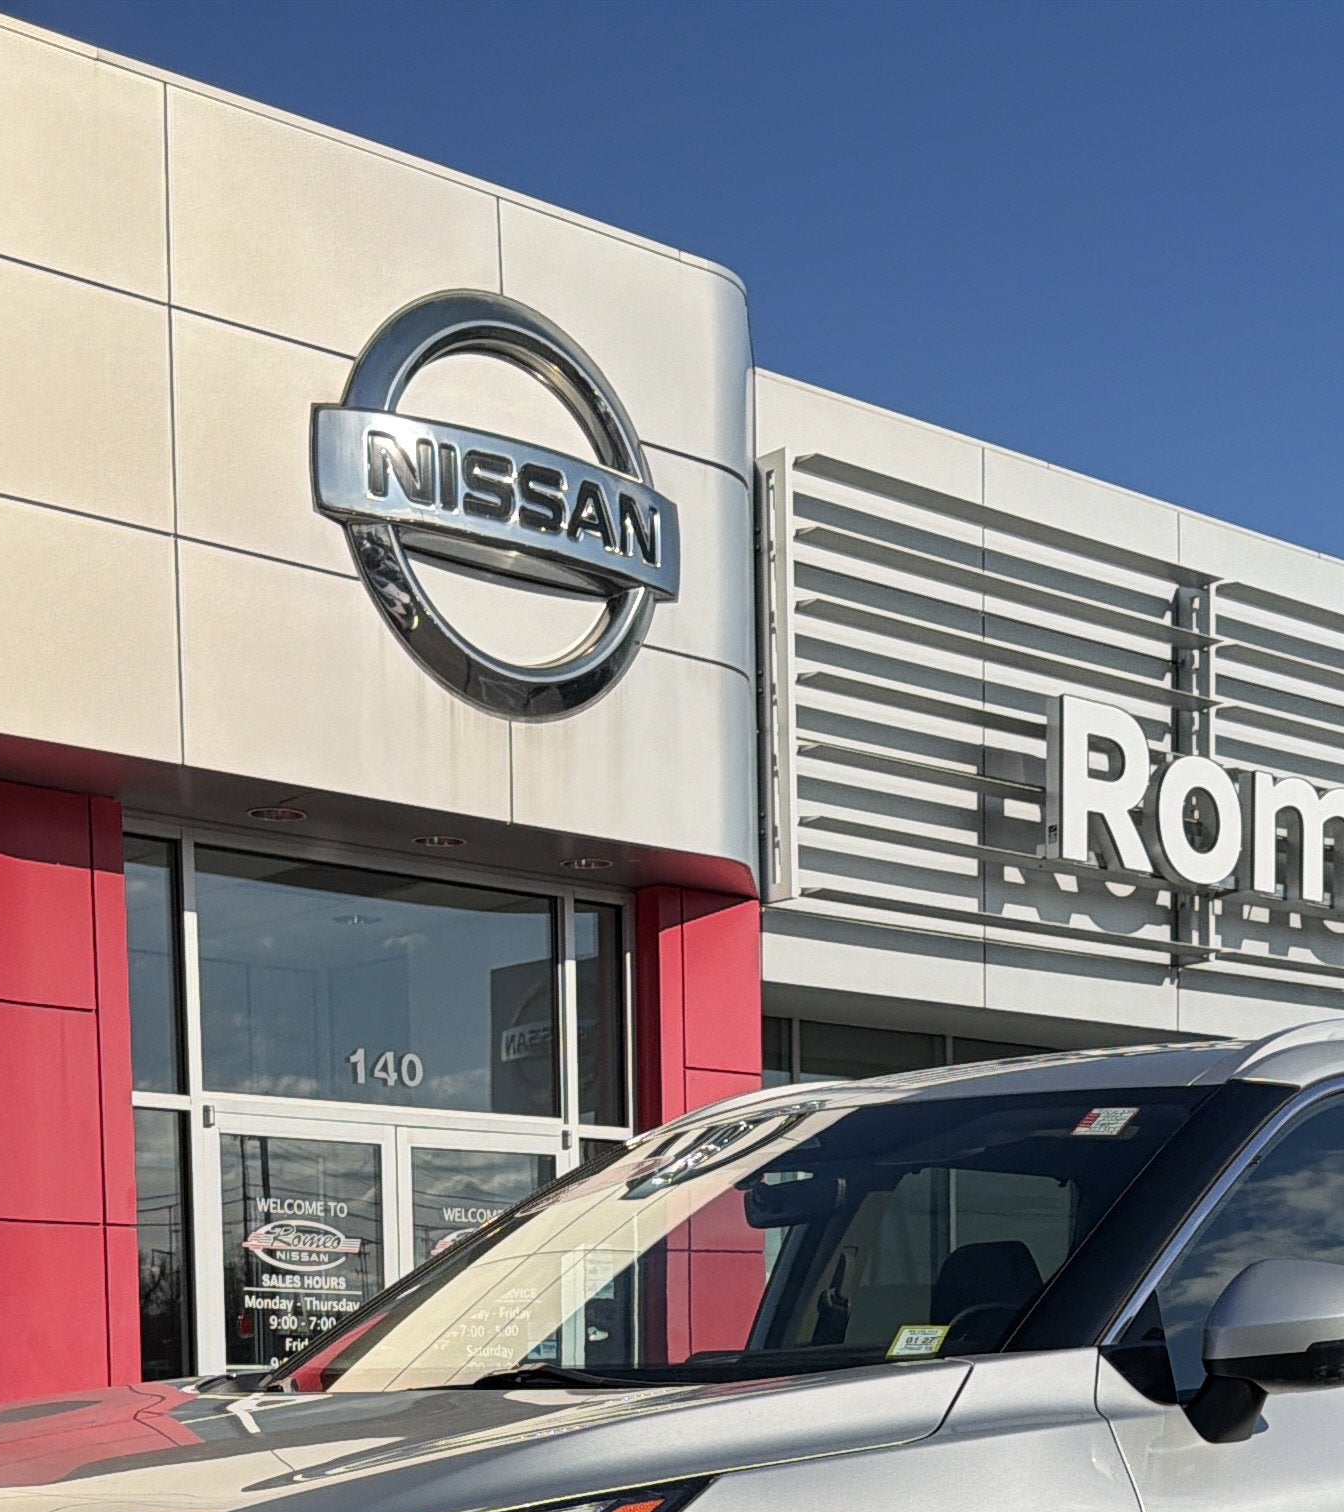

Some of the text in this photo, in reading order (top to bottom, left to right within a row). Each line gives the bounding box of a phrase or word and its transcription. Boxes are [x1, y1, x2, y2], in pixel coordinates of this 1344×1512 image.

[363, 429, 663, 570] NISSAN
[349, 1046, 425, 1089] 140
[256, 1197, 348, 1218] WELCOME TO
[269, 1223, 342, 1249] Romeo
[275, 1250, 329, 1263] NISSAN
[261, 1273, 347, 1290] SALES HOURS
[244, 1295, 294, 1313] Monday
[269, 1315, 298, 1330] 9:00
[309, 1317, 337, 1330] 7:00
[499, 1306, 532, 1321] Friday
